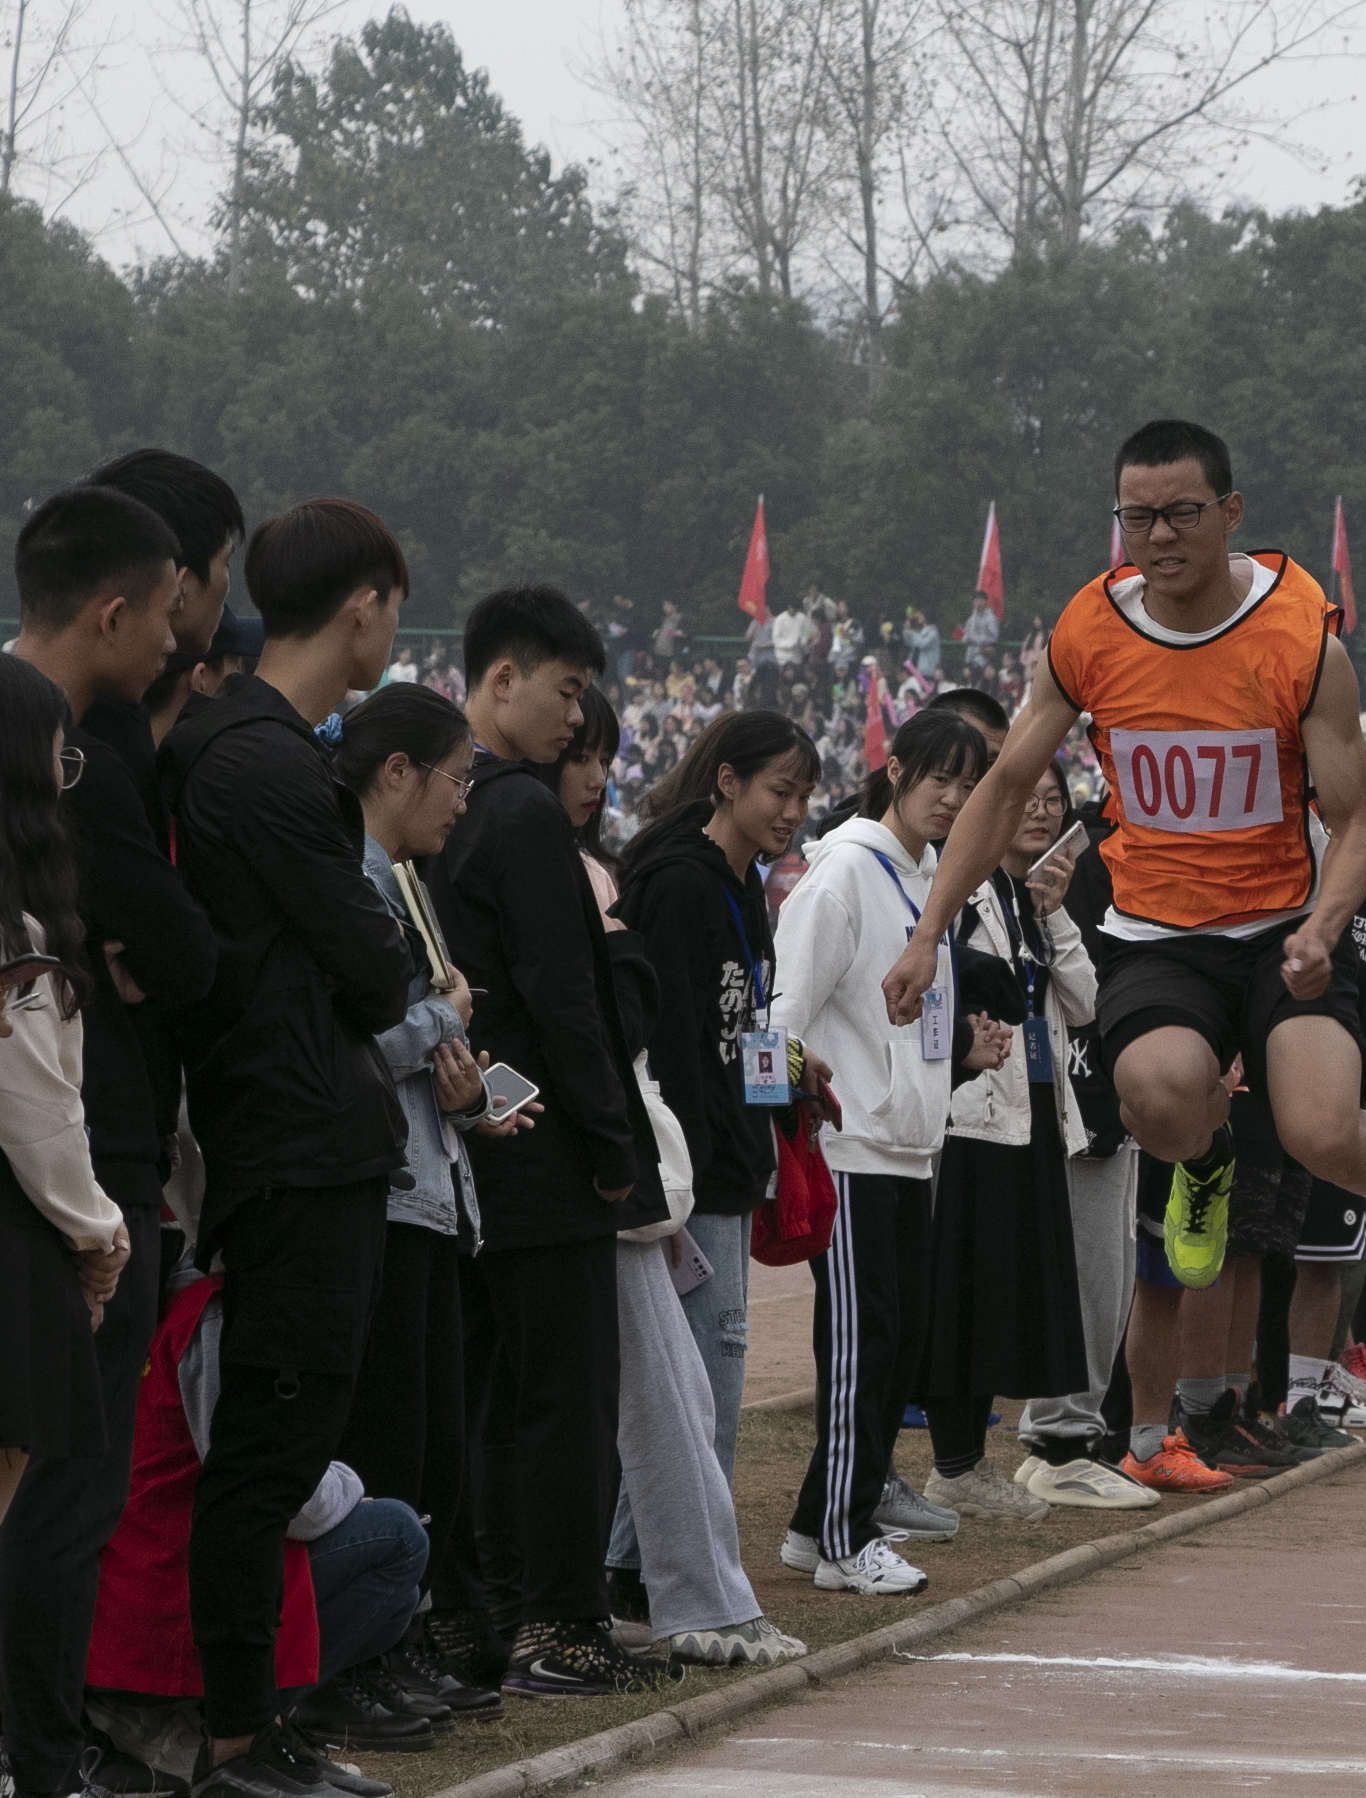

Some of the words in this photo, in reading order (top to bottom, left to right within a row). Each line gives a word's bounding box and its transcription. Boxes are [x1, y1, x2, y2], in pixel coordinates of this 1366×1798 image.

[1131, 744, 1262, 819] 0077
[1028, 1032, 1038, 1060] 记者证
